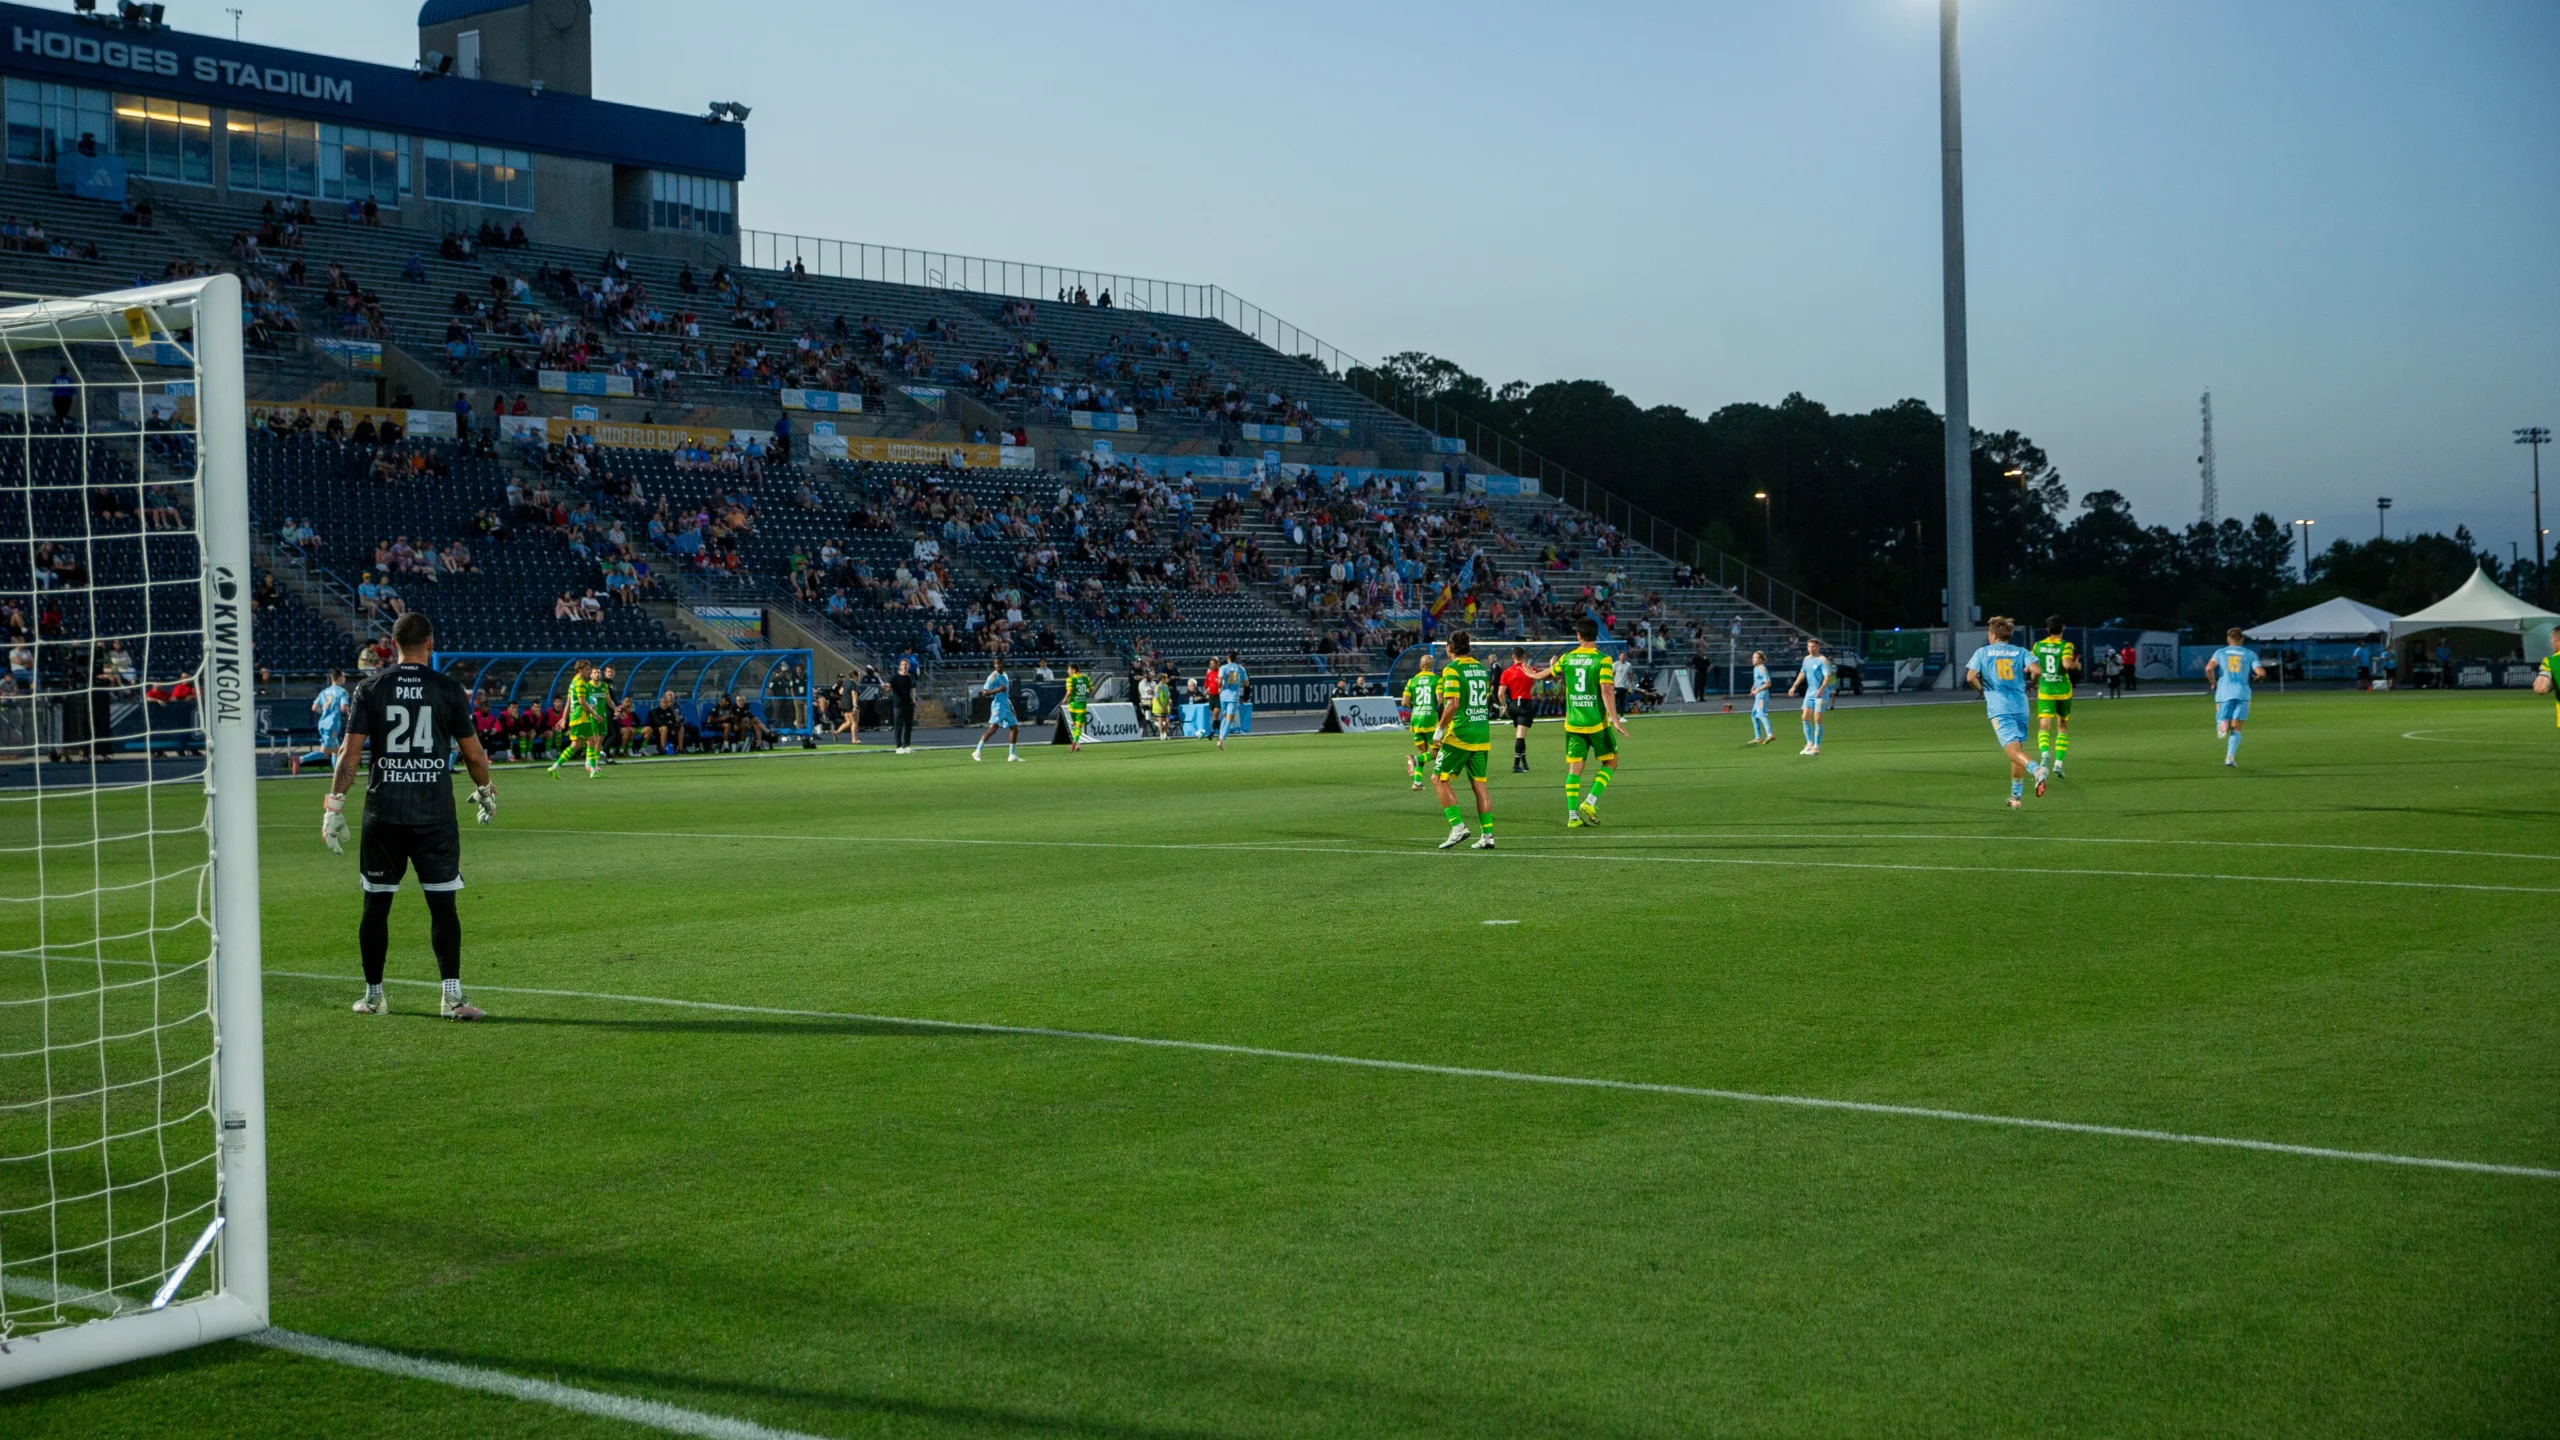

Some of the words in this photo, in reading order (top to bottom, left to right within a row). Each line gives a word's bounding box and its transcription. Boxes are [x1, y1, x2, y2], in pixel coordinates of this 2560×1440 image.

[12, 25, 179, 78] HODGES
[193, 56, 353, 105] STADIUM
[315, 409, 353, 430] CLB
[595, 426, 654, 446] MIDFIELD
[657, 430, 689, 448] CLUB
[887, 443, 937, 461] MIDFIELD
[1995, 658, 2014, 681] 16
[2046, 654, 2056, 674] 8
[1076, 683, 1087, 696] 30
[1574, 667, 1586, 693] 3
[396, 686, 423, 700] PACK
[1250, 683, 1301, 705] LORIDA
[1415, 686, 1432, 705] 26
[1468, 679, 1489, 706] 62
[1085, 711, 1138, 737] Price.com
[1348, 704, 1400, 728] Price.com
[386, 704, 433, 754] 24
[378, 757, 445, 770] ORLANDO
[383, 770, 441, 783] HEALTH
